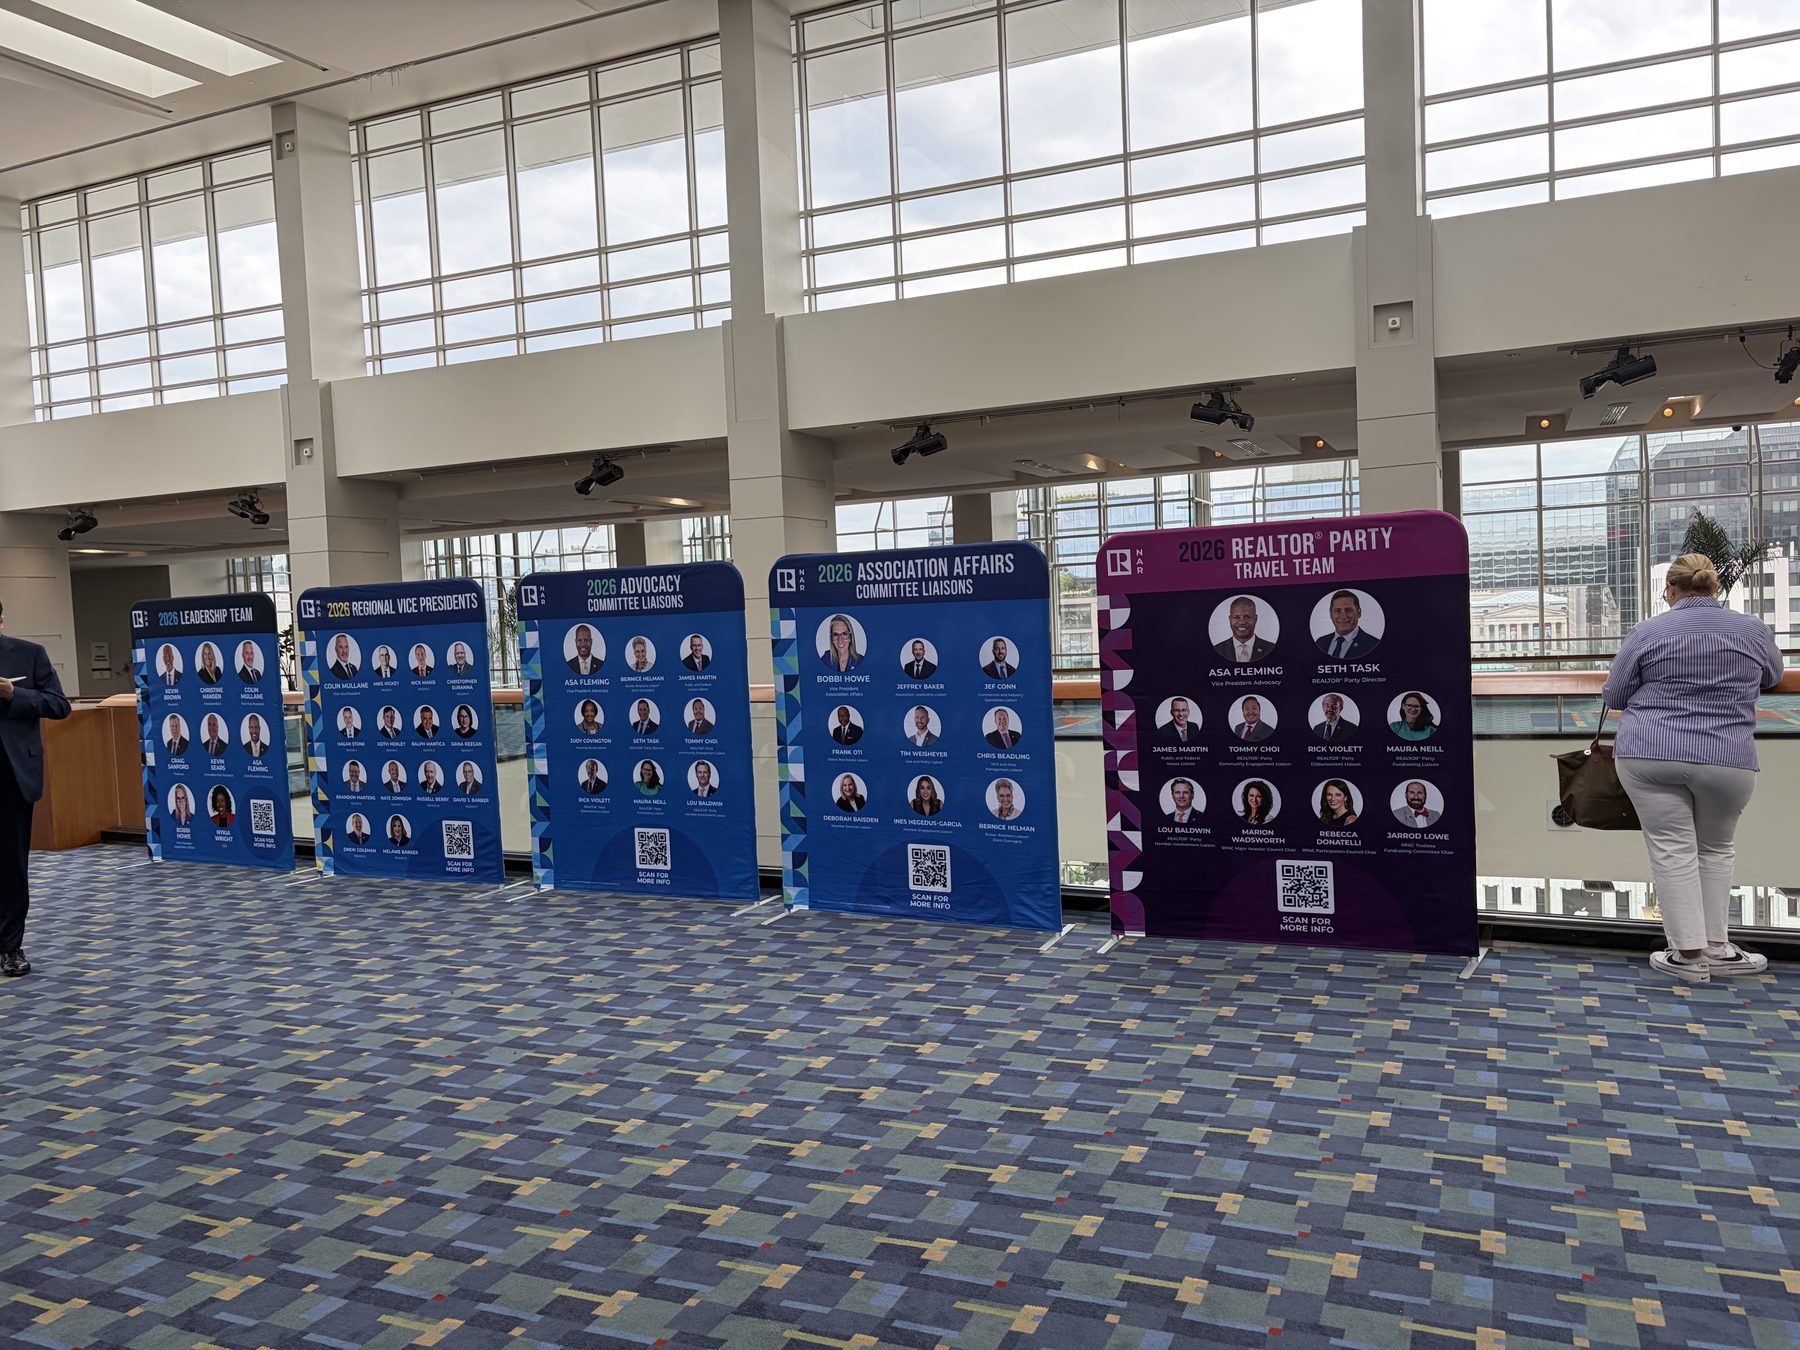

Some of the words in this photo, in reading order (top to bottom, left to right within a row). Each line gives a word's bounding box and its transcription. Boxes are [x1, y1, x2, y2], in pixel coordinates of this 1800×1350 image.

[1178, 539, 1225, 564] 2026
[1329, 526, 1393, 552] PARTY
[818, 564, 852, 582] 2026
[857, 557, 949, 581] ASSOCIATION
[953, 553, 1015, 576] AFFAIRS
[1234, 560, 1289, 580] TRAVEL
[1292, 556, 1335, 576] TEAM
[587, 578, 617, 596] 2026
[620, 575, 681, 595] ADVOCACY
[856, 582, 919, 599] COMMITTEE
[922, 578, 973, 596] LIAISONS
[327, 601, 350, 618] 2026
[351, 600, 395, 617] REGIONAL
[397, 597, 418, 614] VICE
[420, 592, 478, 612] PRESIDENTS
[587, 597, 640, 612] COMMITTEE
[642, 594, 684, 610] LIAISONS
[159, 612, 179, 626] 2026
[180, 608, 228, 625] LEADERSHIP
[229, 607, 253, 622] TEAM
[1208, 668, 1231, 677] ASA
[1234, 666, 1283, 676] FLEMING
[1317, 664, 1347, 674] SETH
[1349, 663, 1380, 673] TASK
[817, 675, 843, 683] BOBBI
[908, 819, 962, 828] HEGEDUS-GARCIA
[1007, 824, 1035, 833] HELMAN
[910, 900, 931, 909] MORE
[1282, 916, 1308, 924] SCAN
[1311, 917, 1331, 925] FOR
[1280, 924, 1308, 933] MORE
[1310, 925, 1334, 934] INFO
